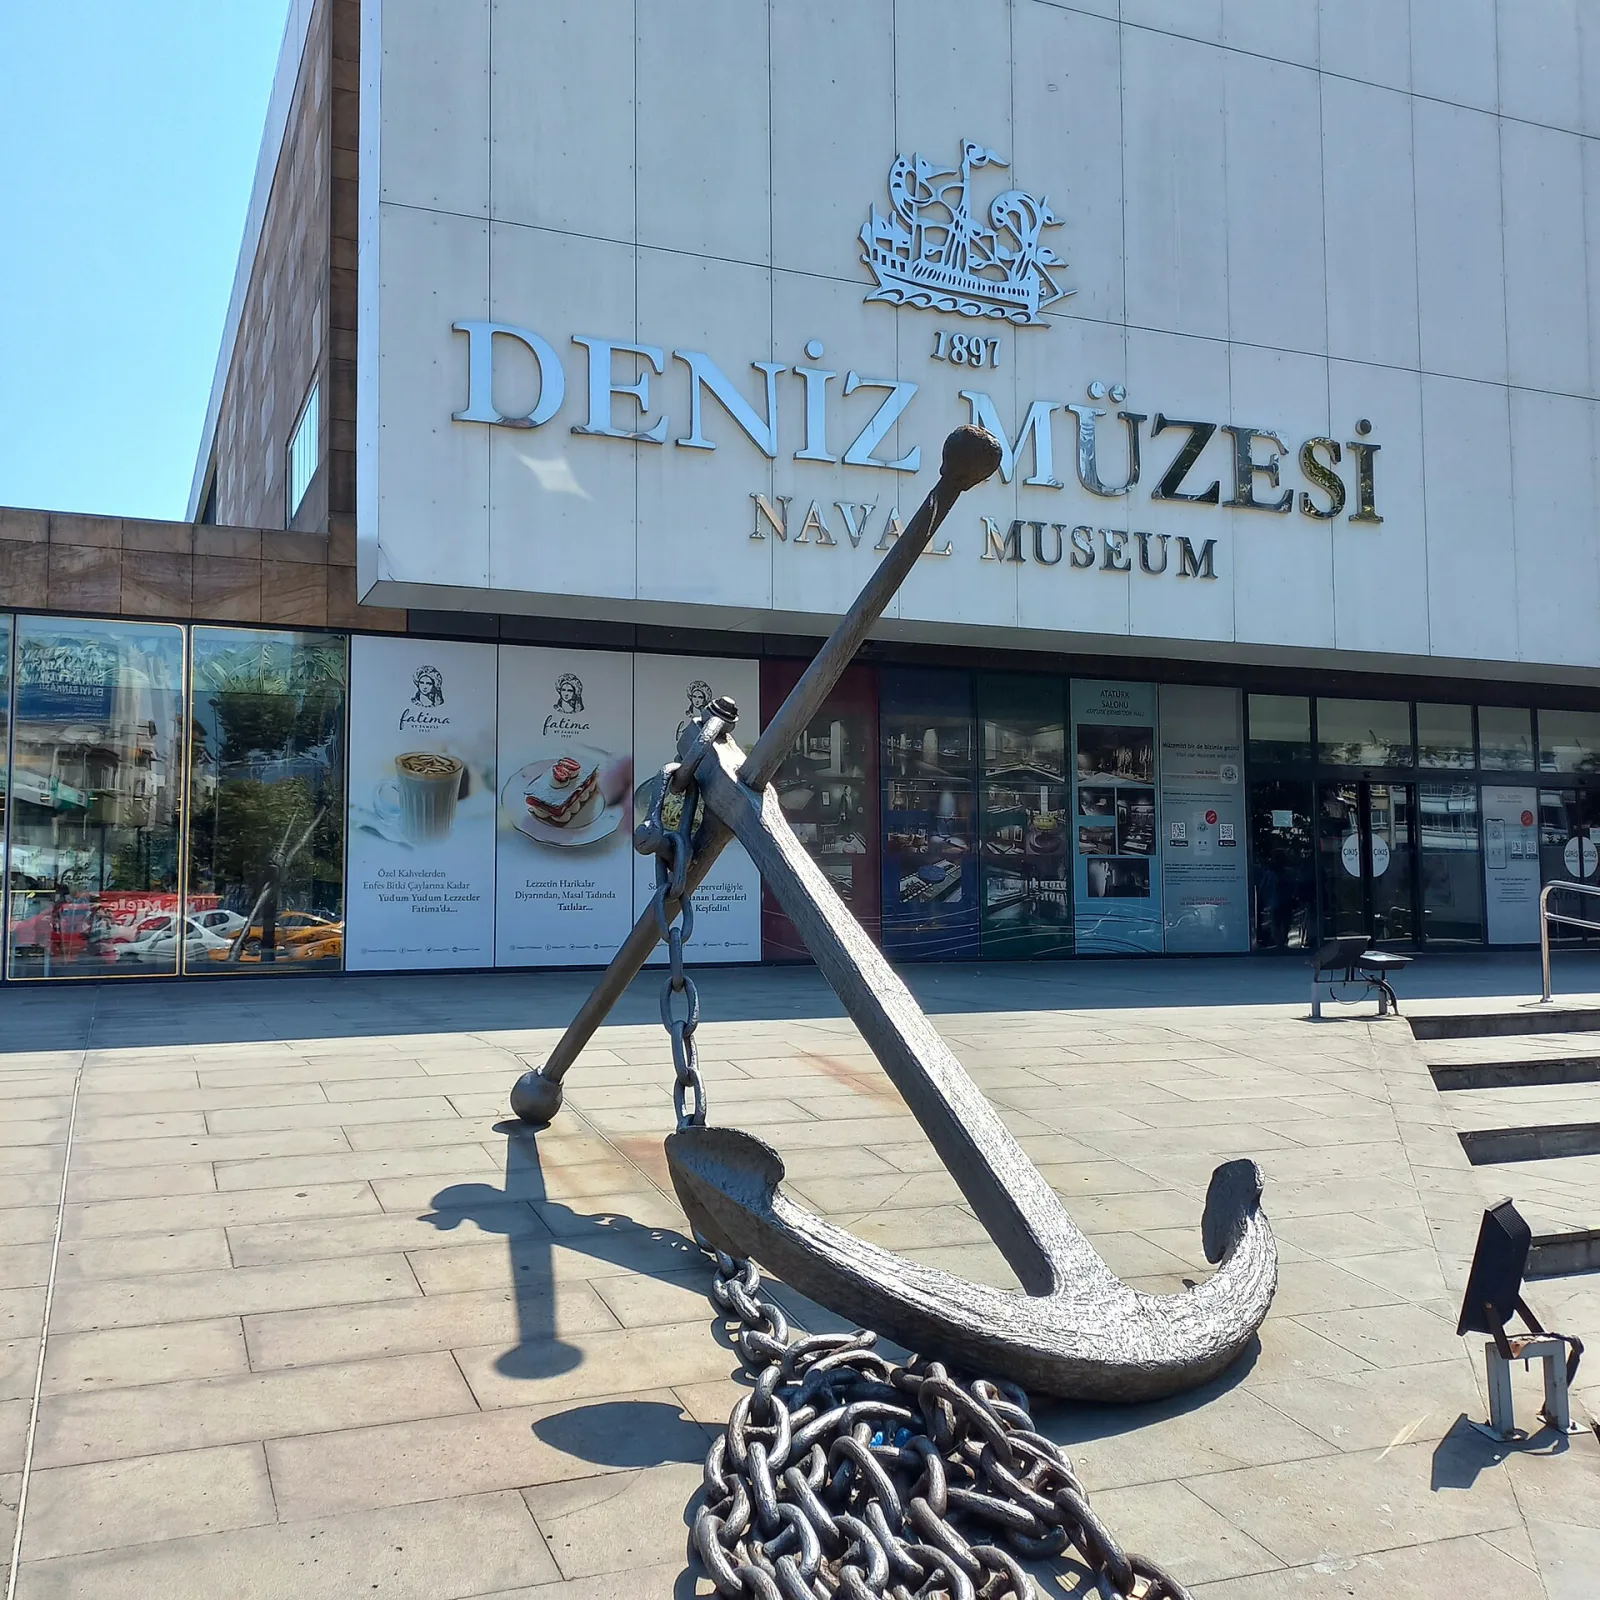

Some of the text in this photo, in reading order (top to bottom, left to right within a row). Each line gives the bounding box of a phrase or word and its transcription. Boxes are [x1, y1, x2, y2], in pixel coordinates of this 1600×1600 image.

[930, 330, 1001, 368] 1897
[451, 321, 1384, 524] DENİZ MÜZESİ
[980, 515, 1219, 580] MUSEUM
[1102, 701, 1129, 709] SALONU
[399, 708, 451, 731] fatima
[542, 714, 591, 736] fatima
[1343, 848, 1358, 857] ÇIKIŞ
[1373, 848, 1388, 857] ÇIKIŞ
[377, 868, 446, 878] Özel Kahvelerden
[363, 881, 385, 890] Enfes
[386, 881, 405, 890] Bitki
[446, 881, 470, 890] Kadar
[525, 879, 595, 888] Lezzetin Harikalar
[378, 893, 480, 902] Yudum Yudum Lezzetler
[562, 891, 584, 899] Masal
[585, 890, 616, 899] Tadında
